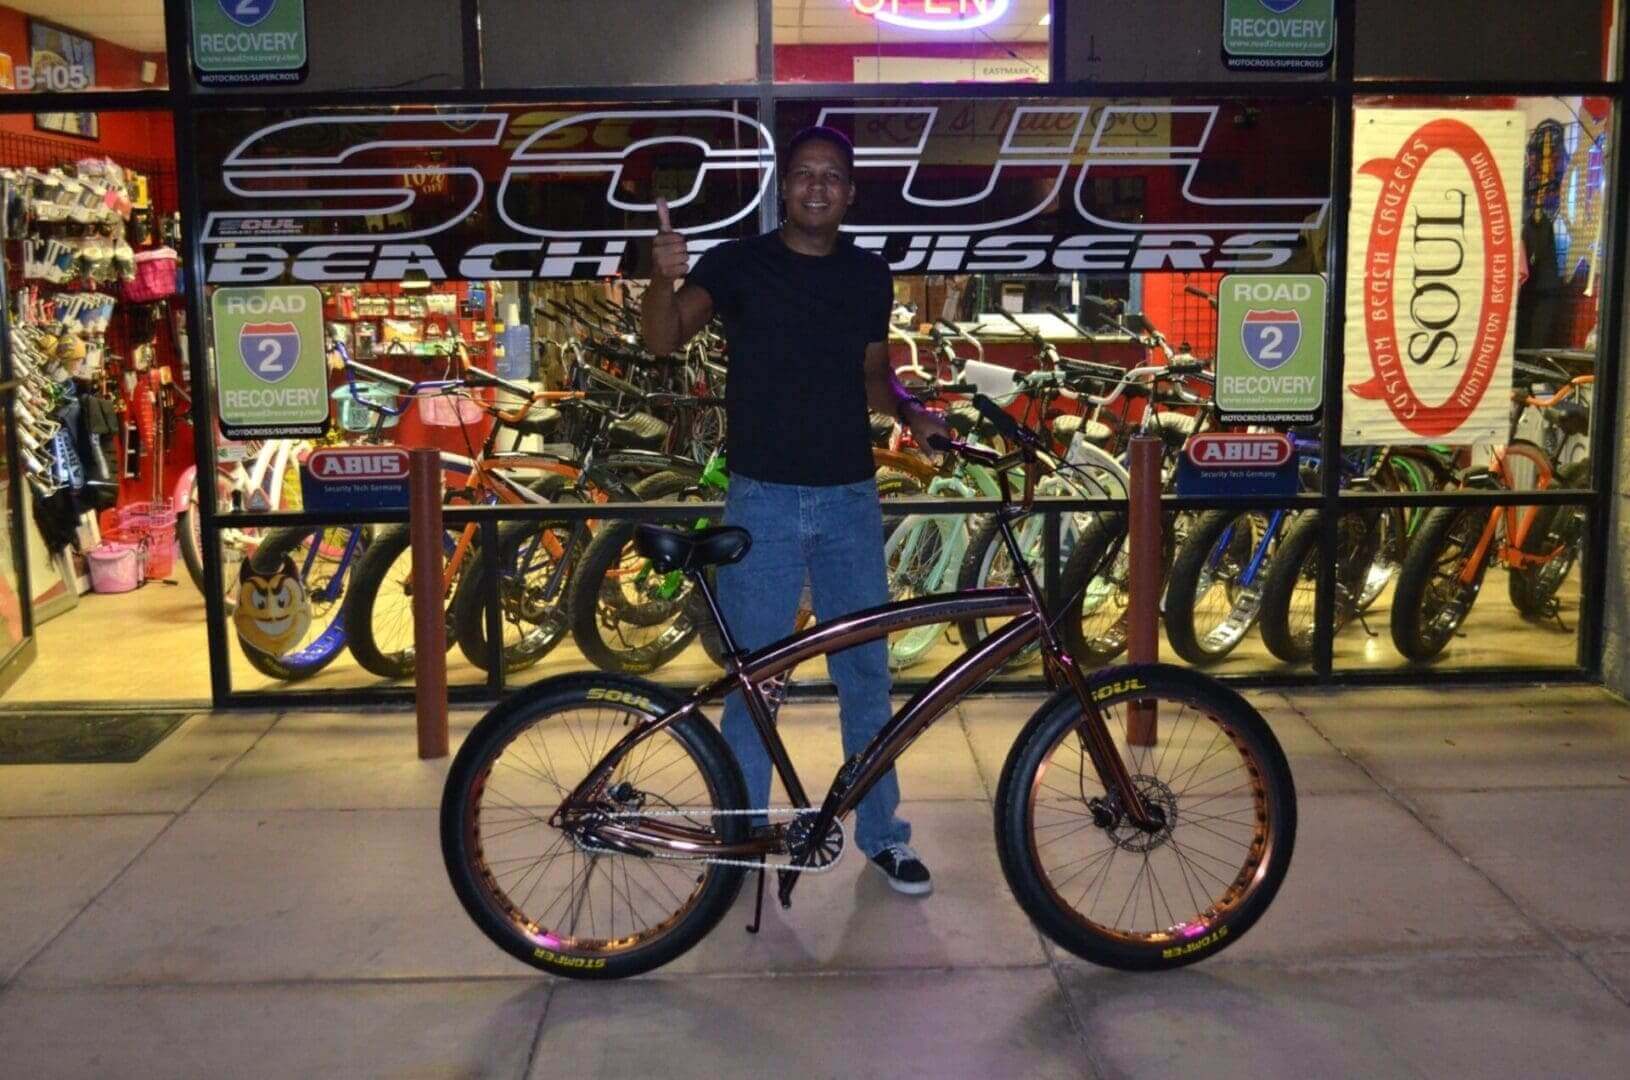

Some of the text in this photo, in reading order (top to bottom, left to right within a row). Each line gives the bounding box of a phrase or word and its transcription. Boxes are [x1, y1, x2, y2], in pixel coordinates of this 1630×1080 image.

[1229, 18, 1326, 38] RECOVERY
[200, 32, 298, 52] RECOVERY
[1228, 58, 1324, 68] MOTOCROSS/SUPERCROSS
[15, 65, 87, 90] B-105
[201, 72, 300, 82] MOTOCROSS/SUPERCROSS
[200, 105, 1330, 243] SOUL
[206, 233, 1300, 283] BEACH UISERS
[1371, 138, 1429, 419] CUSTOM BEACH CRUZERS
[1408, 188, 1468, 370] SOUL
[1458, 151, 1506, 408] HUNTINGTON BEACH CALIFORNIA
[1234, 283, 1311, 301] ROAD
[226, 295, 306, 315] ROAD
[1259, 326, 1283, 359] 2
[258, 338, 284, 372] 2
[1223, 376, 1316, 395] RECOVERY
[225, 388, 320, 408] RECOVERY
[1220, 414, 1314, 422] MOTOCROSS/SUPERCROSS
[227, 426, 322, 436] MOTOCROSS/SUPERCROSS
[1202, 442, 1279, 460] ABUS
[323, 456, 400, 475] ABUS
[1201, 470, 1228, 480] Security
[324, 484, 351, 493] Security
[586, 687, 666, 714] SOUL
[534, 947, 607, 968] STOMPER
